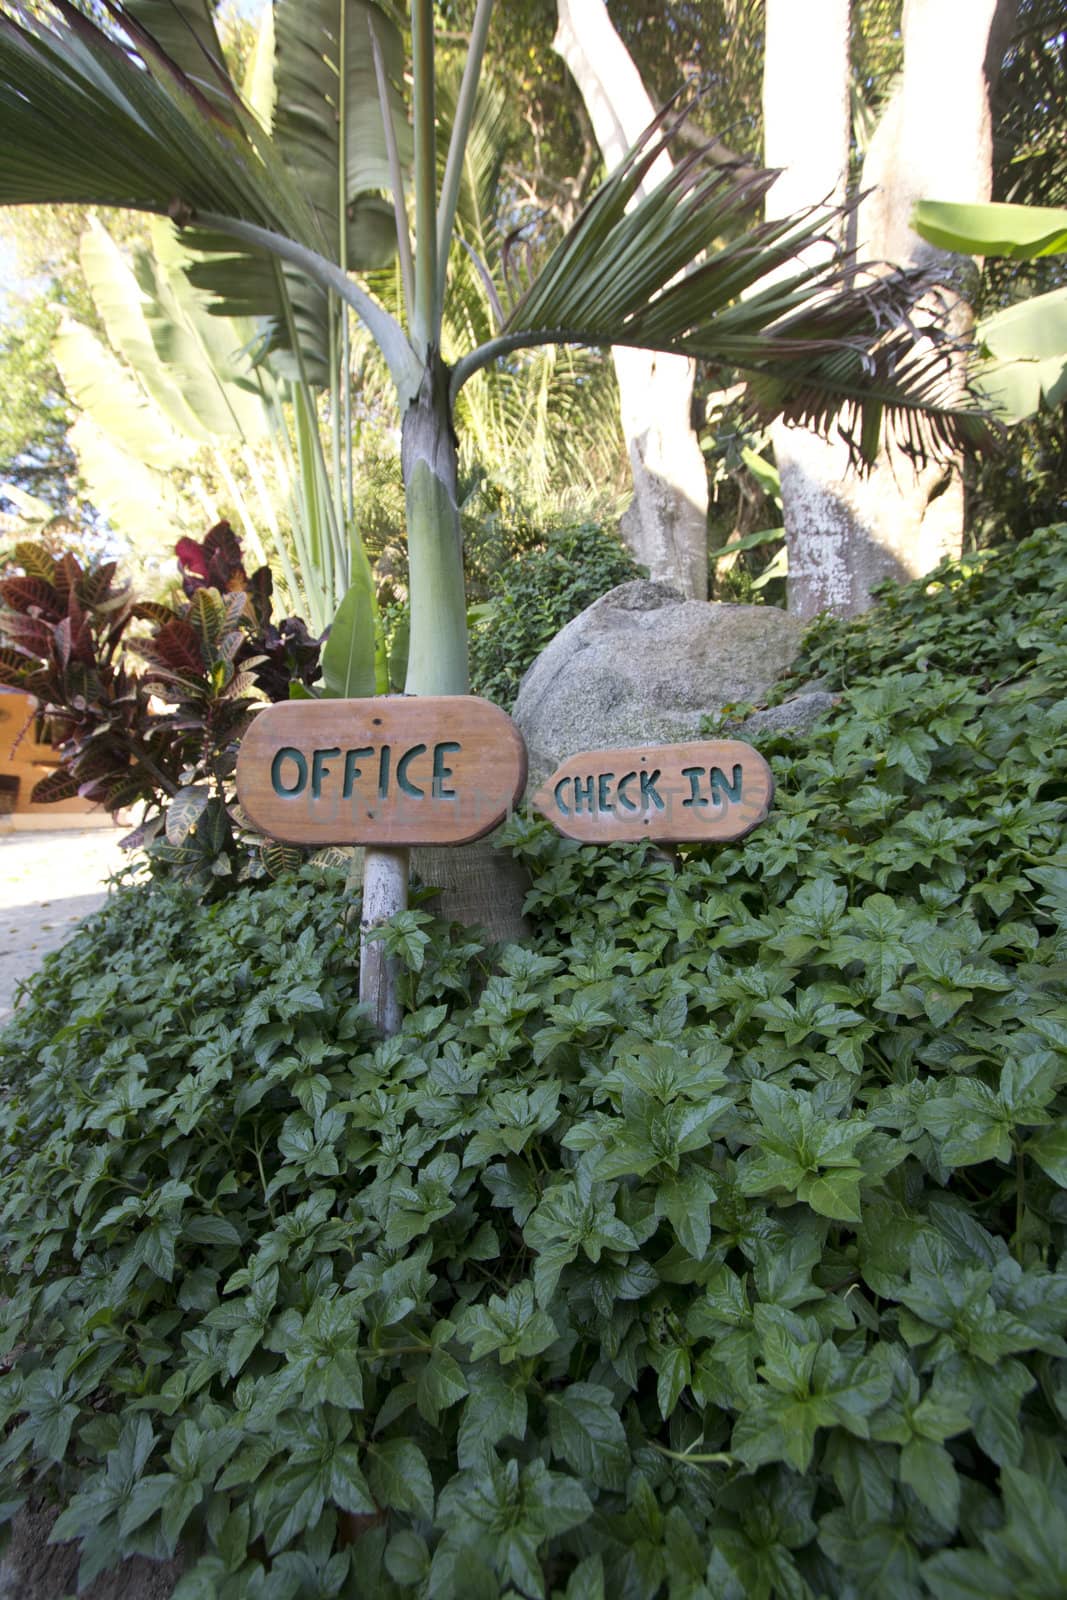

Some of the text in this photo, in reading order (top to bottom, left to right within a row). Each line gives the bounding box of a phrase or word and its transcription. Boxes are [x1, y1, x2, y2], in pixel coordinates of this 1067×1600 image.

[270, 742, 462, 801] OFFICE
[554, 763, 743, 815] CHECK IN
